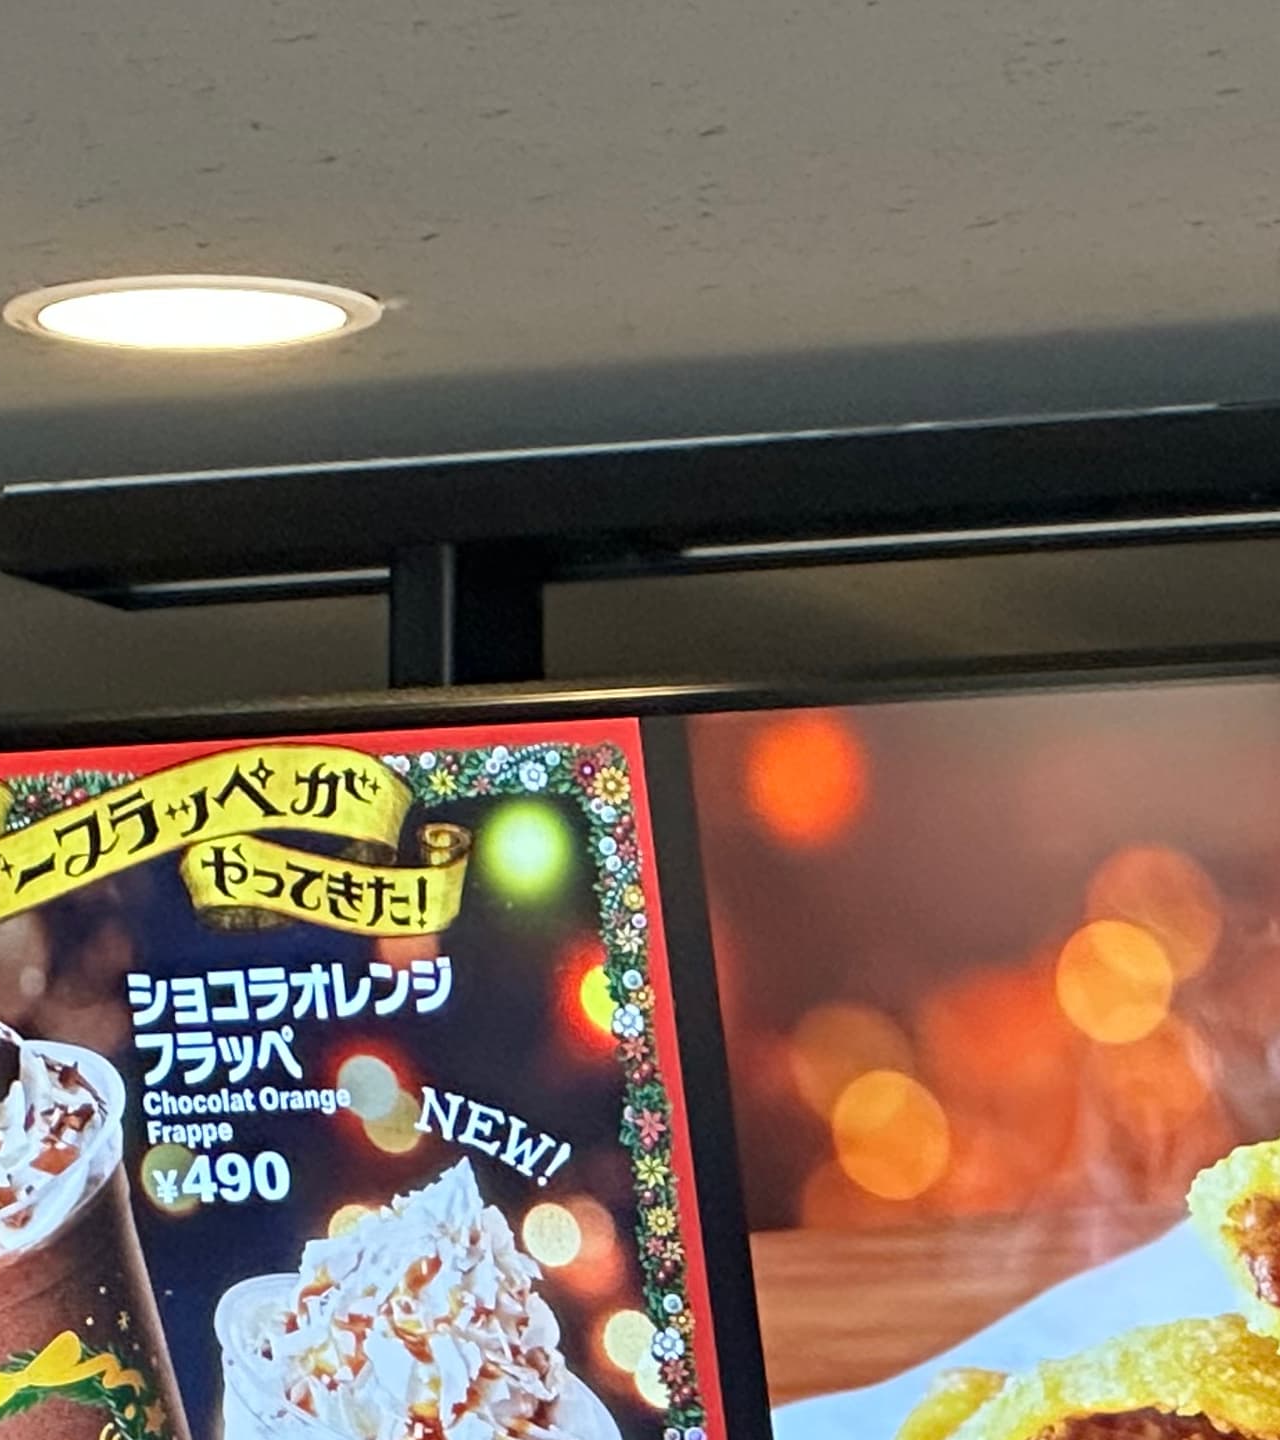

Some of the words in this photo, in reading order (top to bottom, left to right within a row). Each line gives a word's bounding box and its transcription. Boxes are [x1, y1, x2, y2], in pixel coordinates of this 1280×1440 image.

[200, 844, 428, 930] やってきた!
[128, 956, 453, 1026] ショコラオレンジ
[134, 1029, 304, 1084] フラッペ
[142, 1088, 255, 1114] Chocolat
[259, 1085, 350, 1114] Orange
[147, 1119, 233, 1147] Frappe
[414, 1086, 573, 1188] NEW!
[151, 1152, 290, 1205] ¥490
